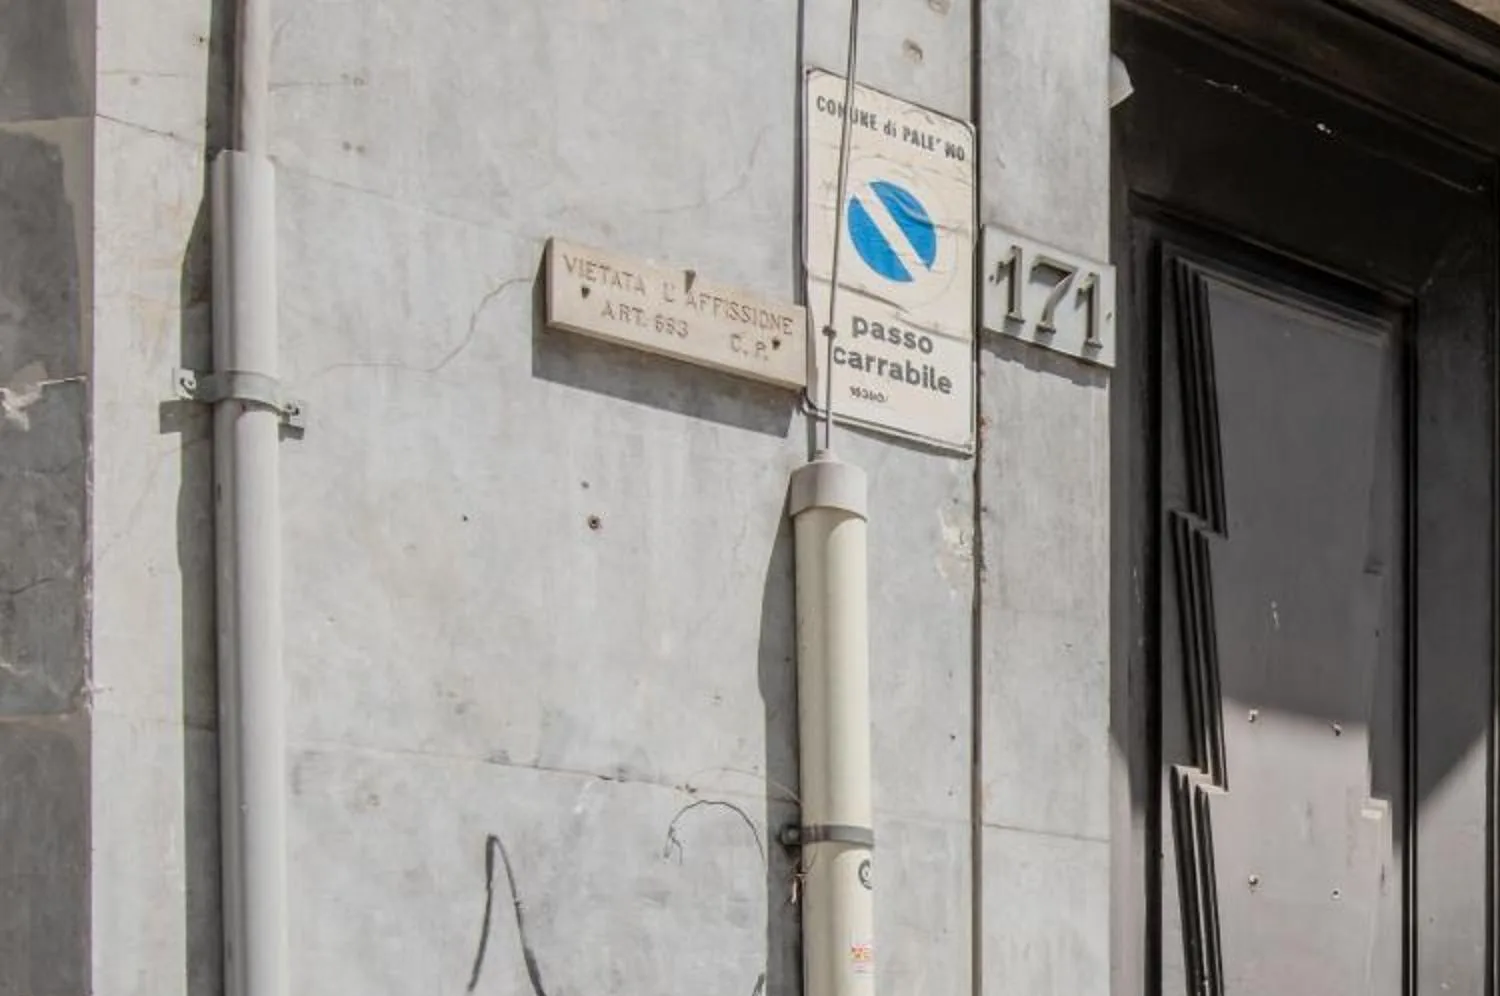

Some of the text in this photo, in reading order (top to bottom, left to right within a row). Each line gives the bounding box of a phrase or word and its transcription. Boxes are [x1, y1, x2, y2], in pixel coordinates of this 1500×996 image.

[884, 119, 897, 138] di
[902, 125, 966, 162] PALEMO
[562, 254, 646, 296] VIETATA
[996, 245, 1104, 349] 171
[851, 315, 934, 354] passo
[833, 346, 953, 394] carrabile
